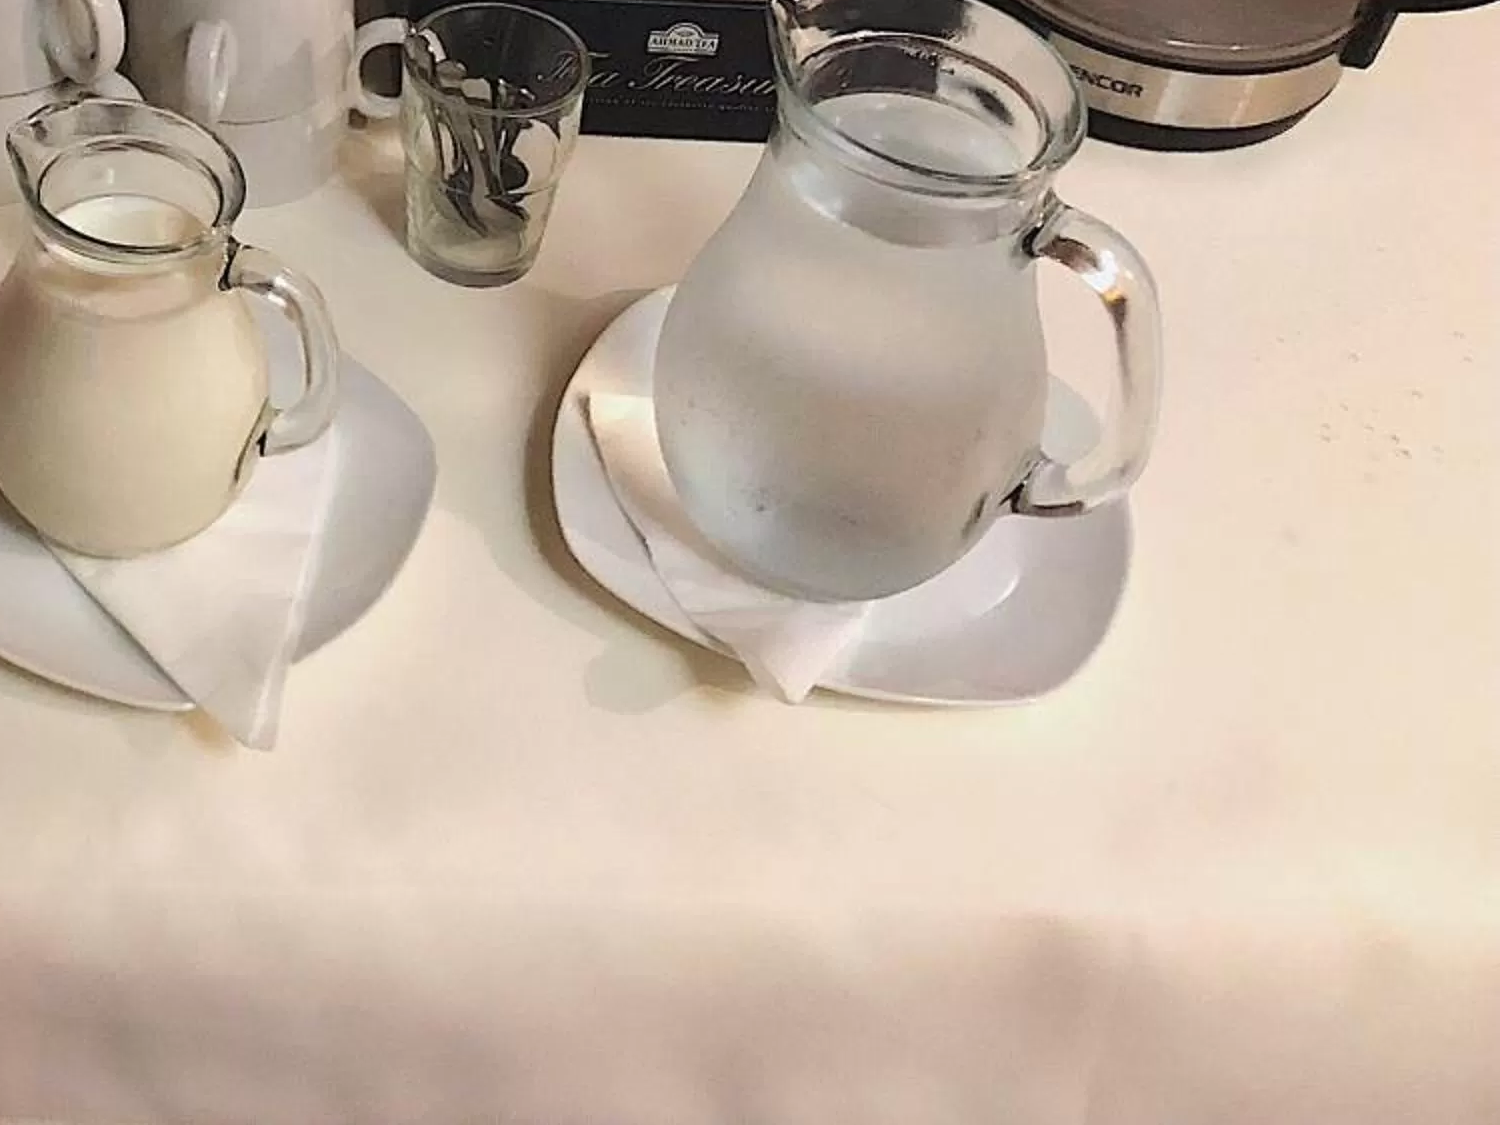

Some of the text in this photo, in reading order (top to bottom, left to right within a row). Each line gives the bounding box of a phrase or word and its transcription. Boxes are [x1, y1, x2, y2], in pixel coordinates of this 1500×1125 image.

[649, 36, 718, 51] AHMAD TEA
[627, 54, 777, 97] Treasu
[1069, 63, 1144, 98] ENCOR
